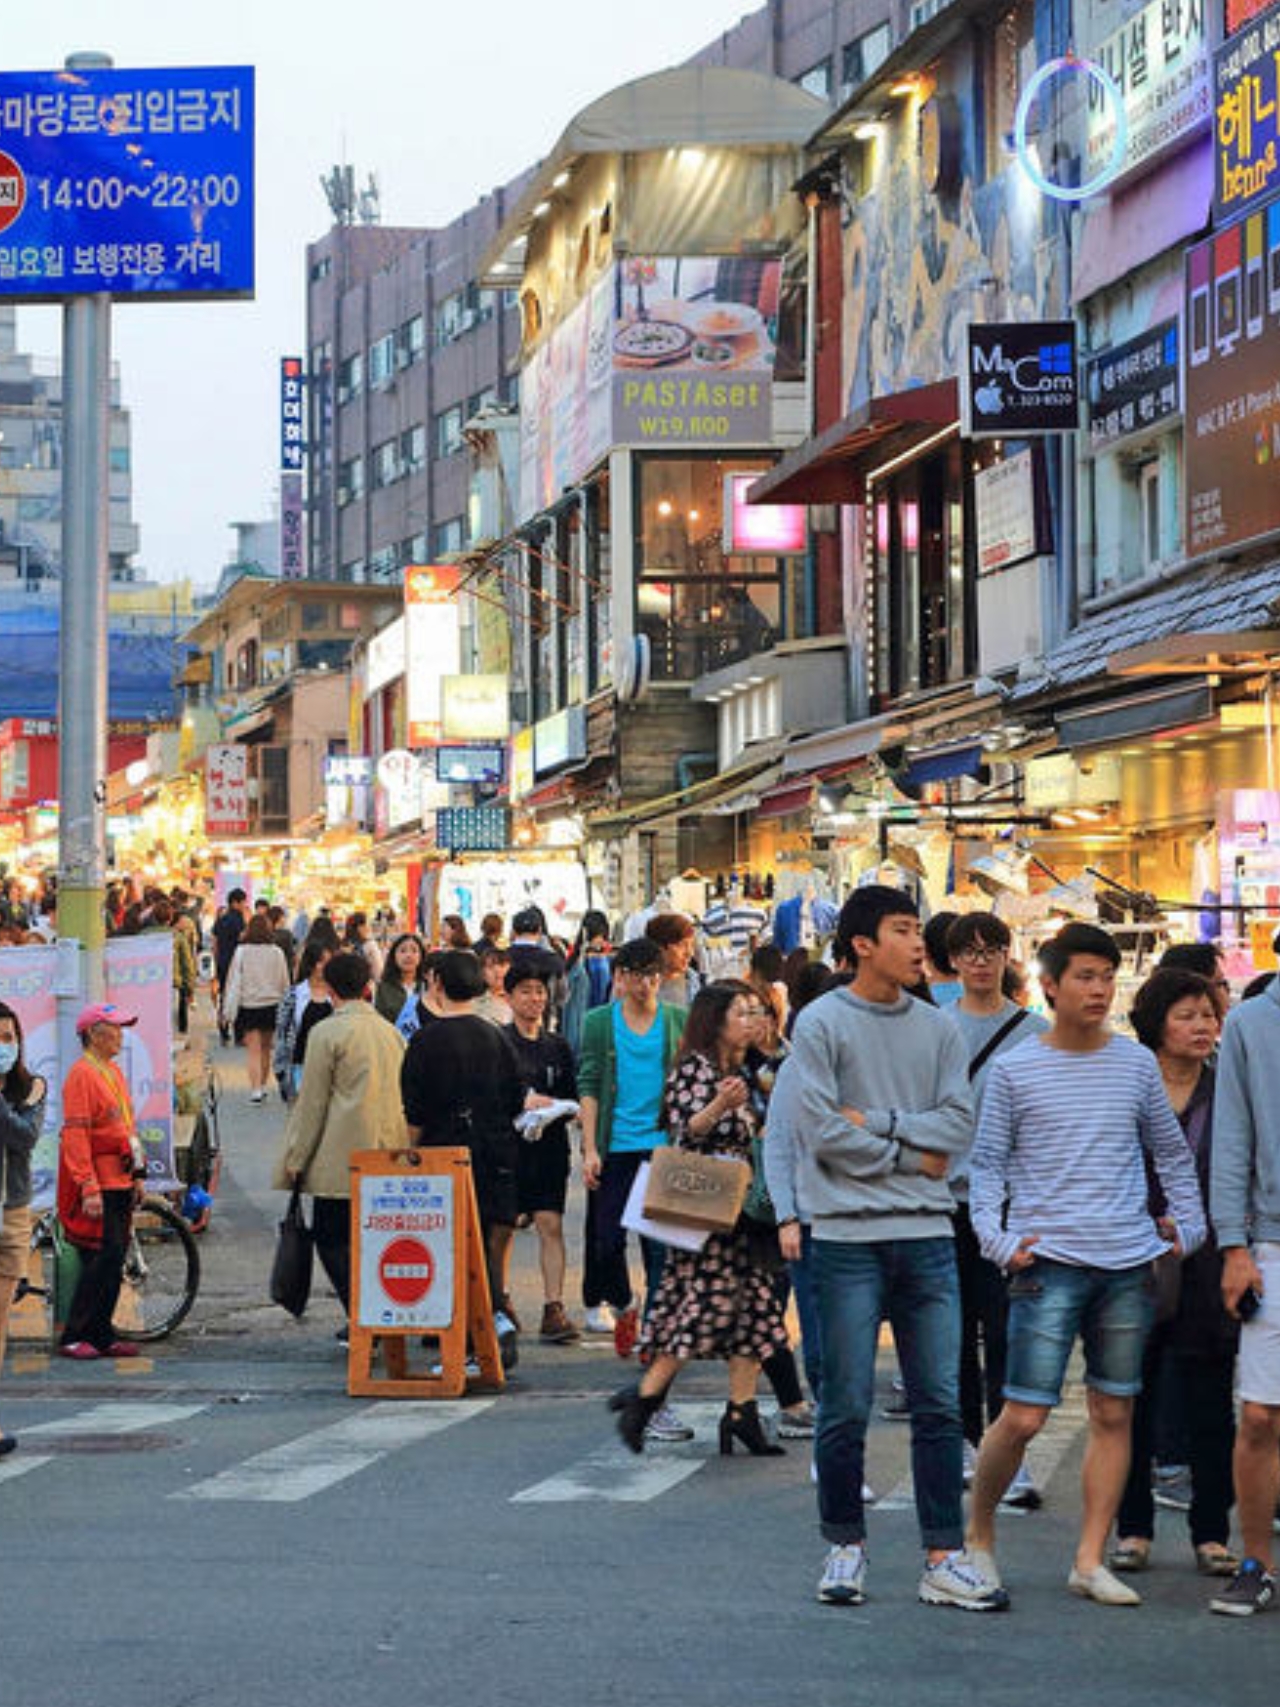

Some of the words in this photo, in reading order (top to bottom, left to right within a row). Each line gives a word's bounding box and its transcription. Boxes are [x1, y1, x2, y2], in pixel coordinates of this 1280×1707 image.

[112, 88, 241, 134] 진입금지
[38, 174, 240, 210] 14:00~22:00
[72, 241, 166, 276] 보행전용
[175, 240, 222, 274] 거리
